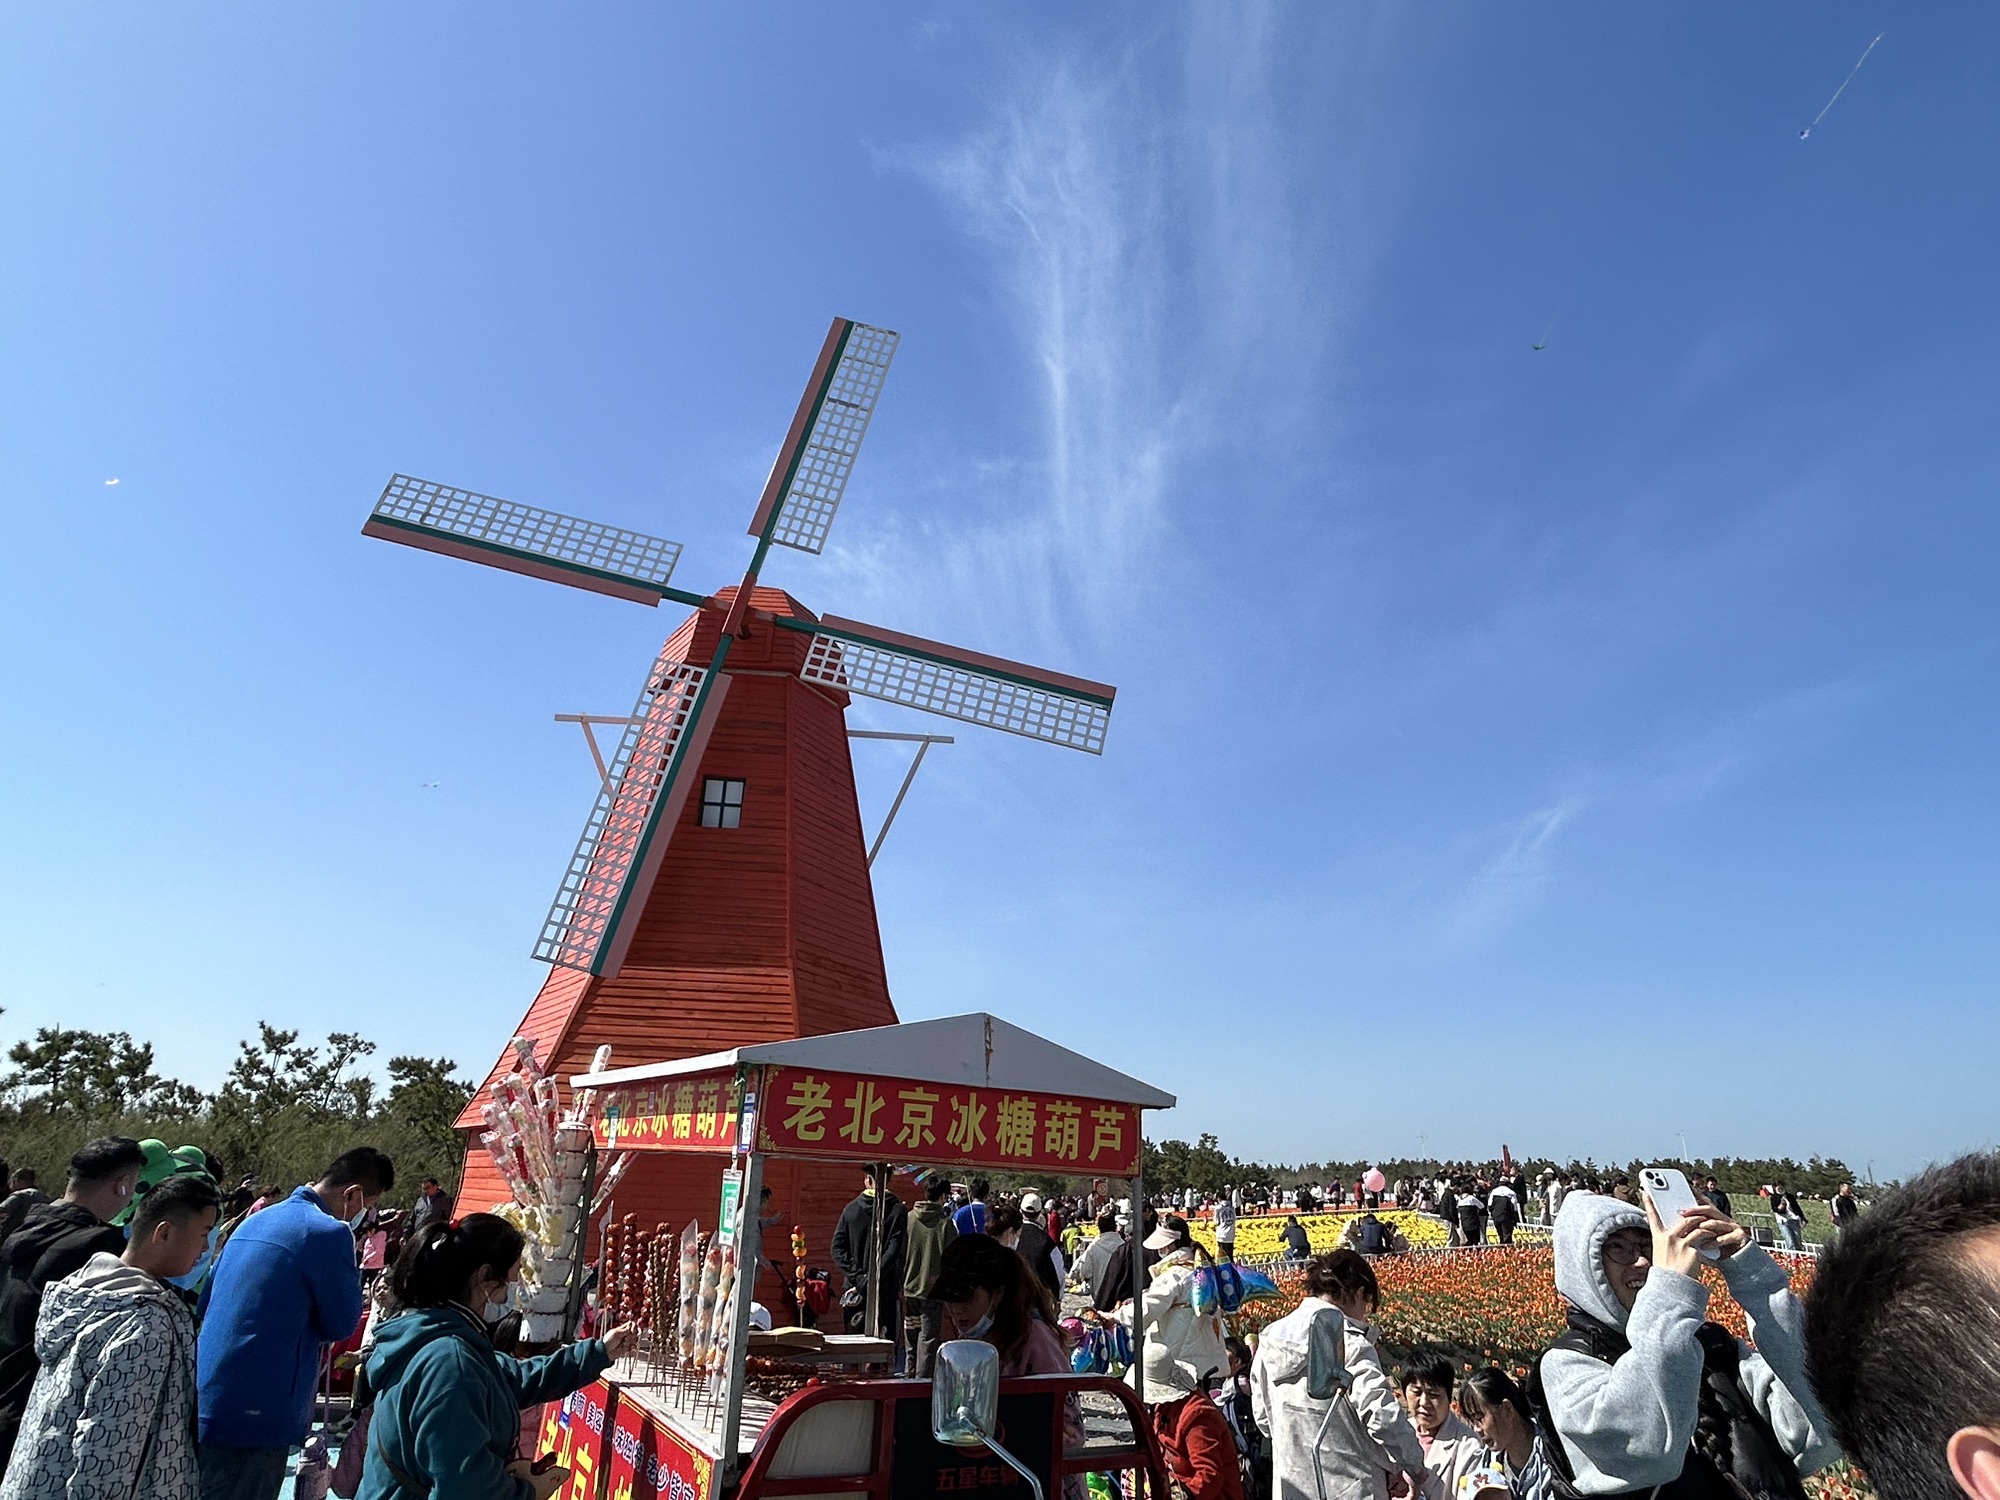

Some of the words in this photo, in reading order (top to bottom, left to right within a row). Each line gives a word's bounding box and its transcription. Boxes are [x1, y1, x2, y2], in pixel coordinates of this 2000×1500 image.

[782, 1075, 1125, 1161] 老北京冰糖葫芦
[935, 1465, 1019, 1491] 五星车辆
